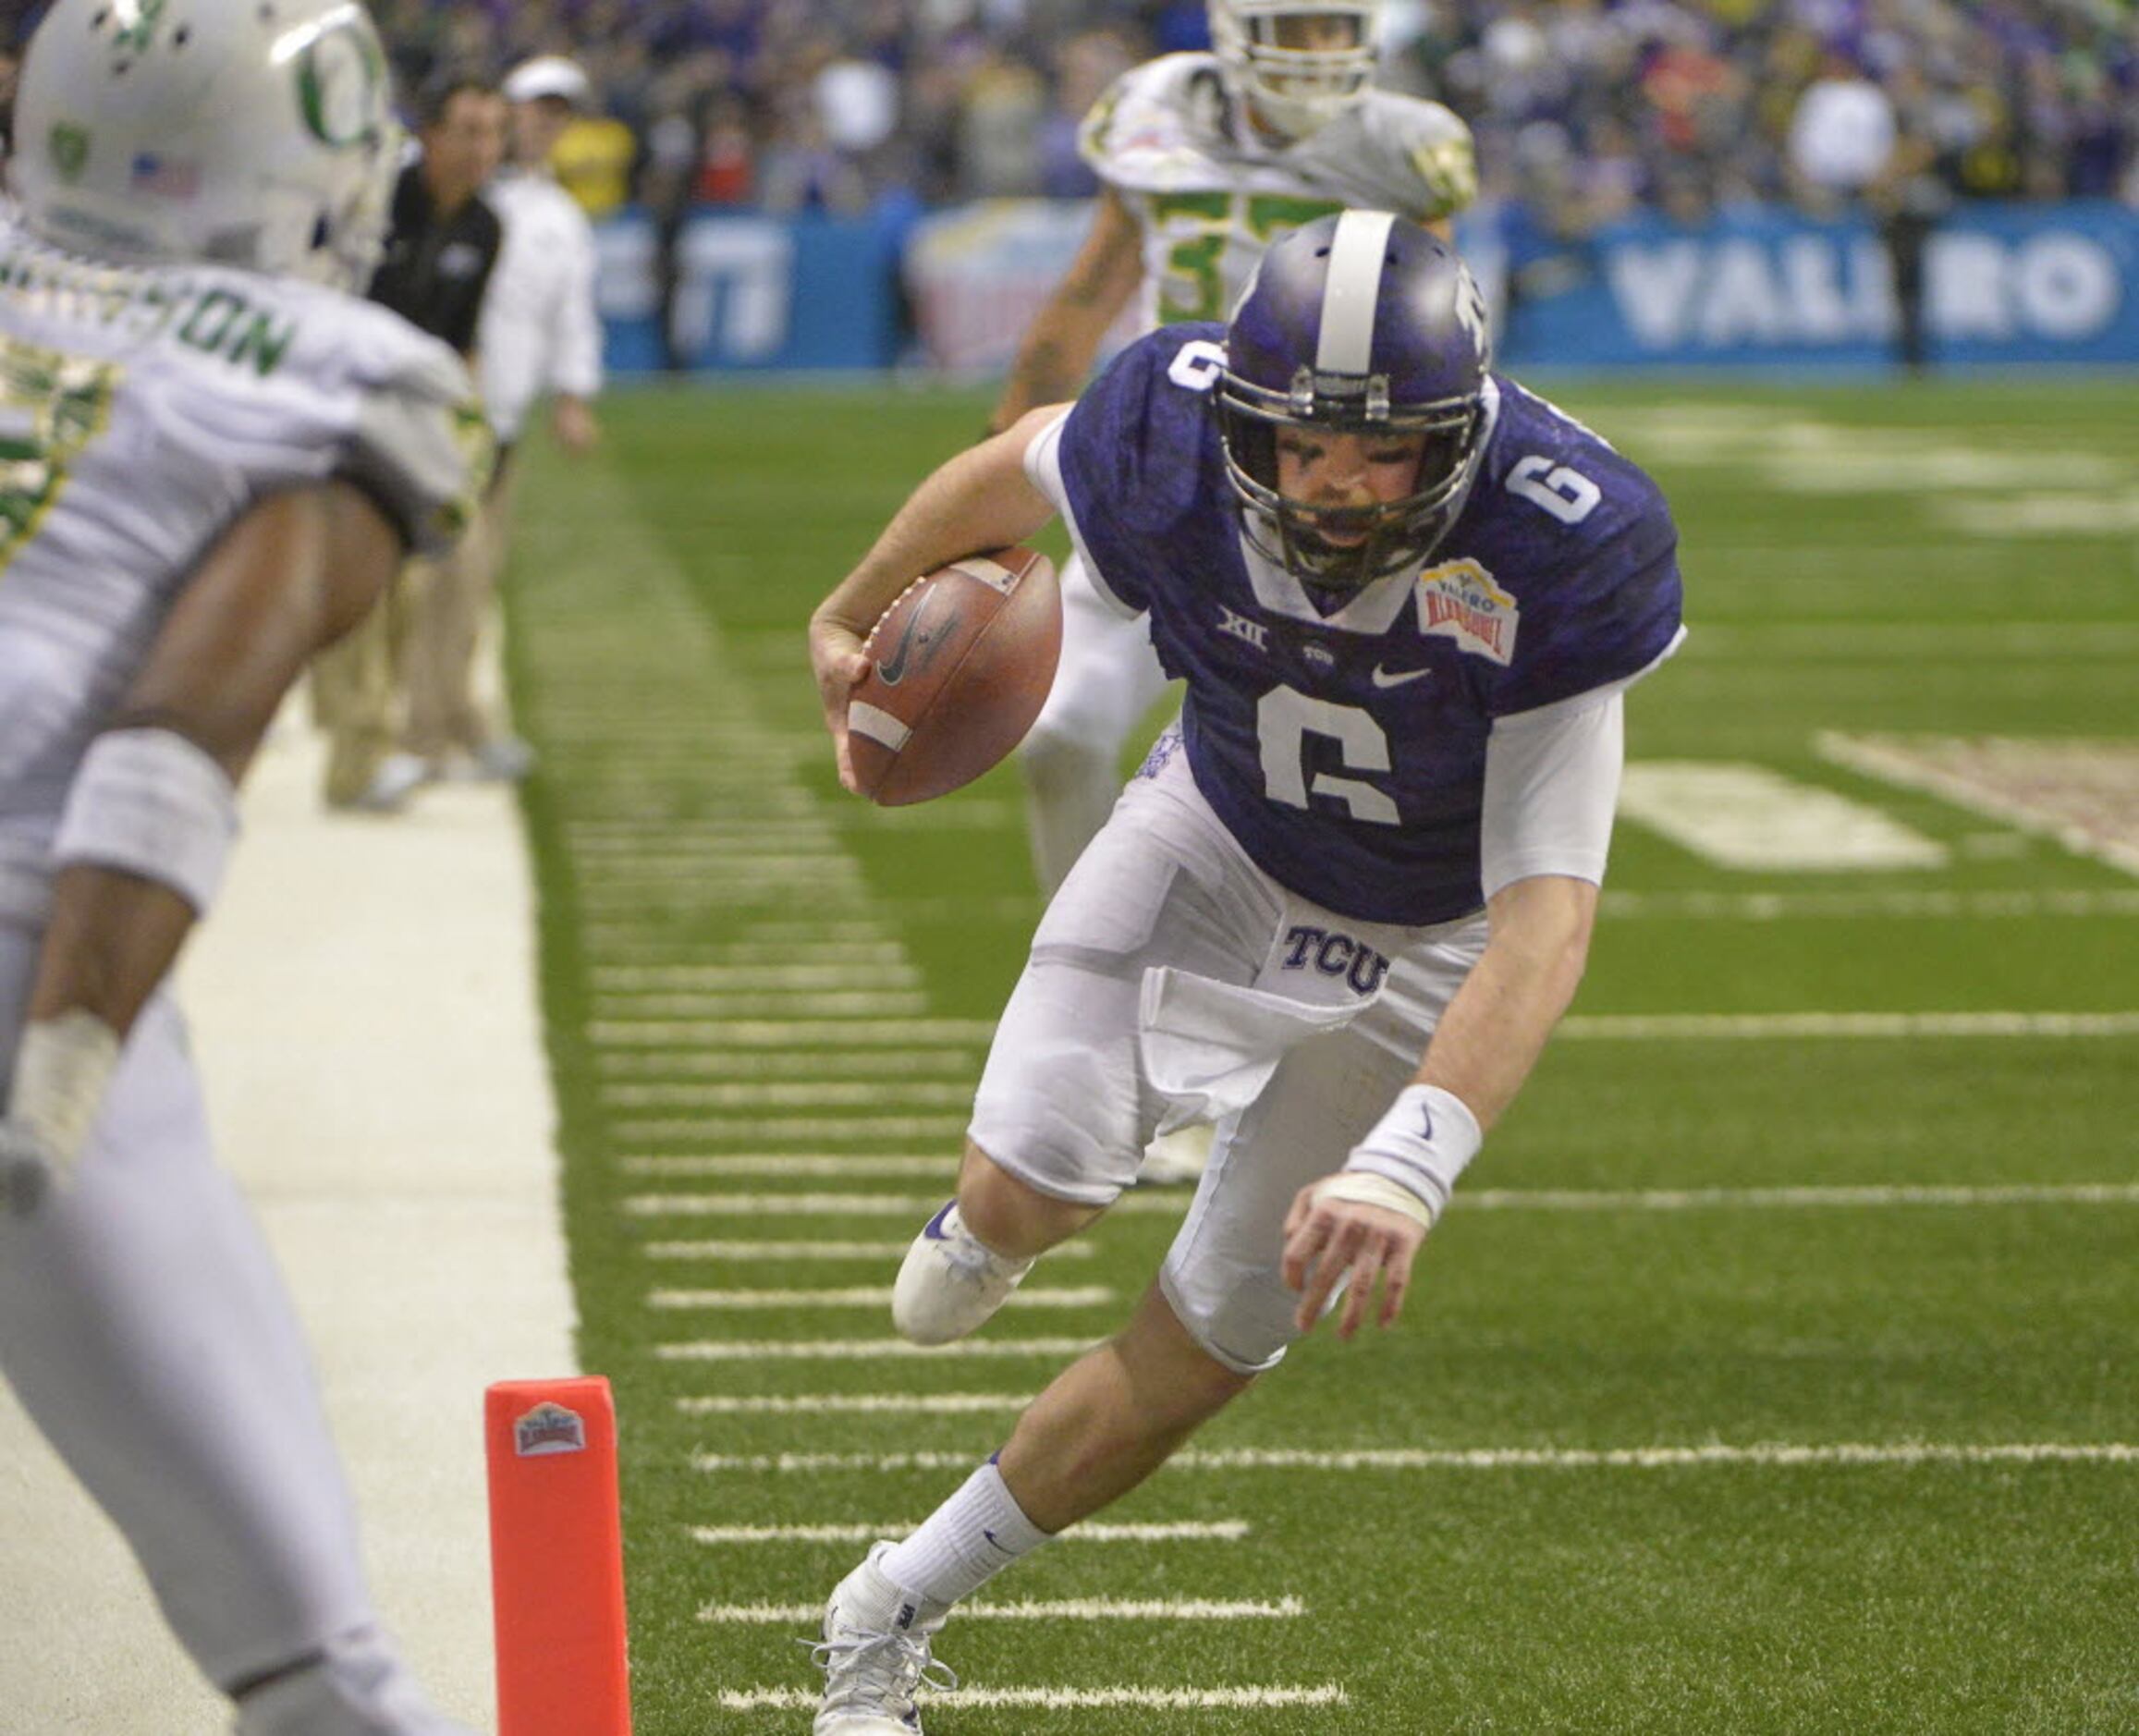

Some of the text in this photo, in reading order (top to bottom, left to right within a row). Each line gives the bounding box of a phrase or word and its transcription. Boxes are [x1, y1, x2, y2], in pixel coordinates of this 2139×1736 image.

[1504, 455, 1602, 524] 6
[1257, 682, 1401, 825] 6
[1281, 925, 1390, 996] TCU
